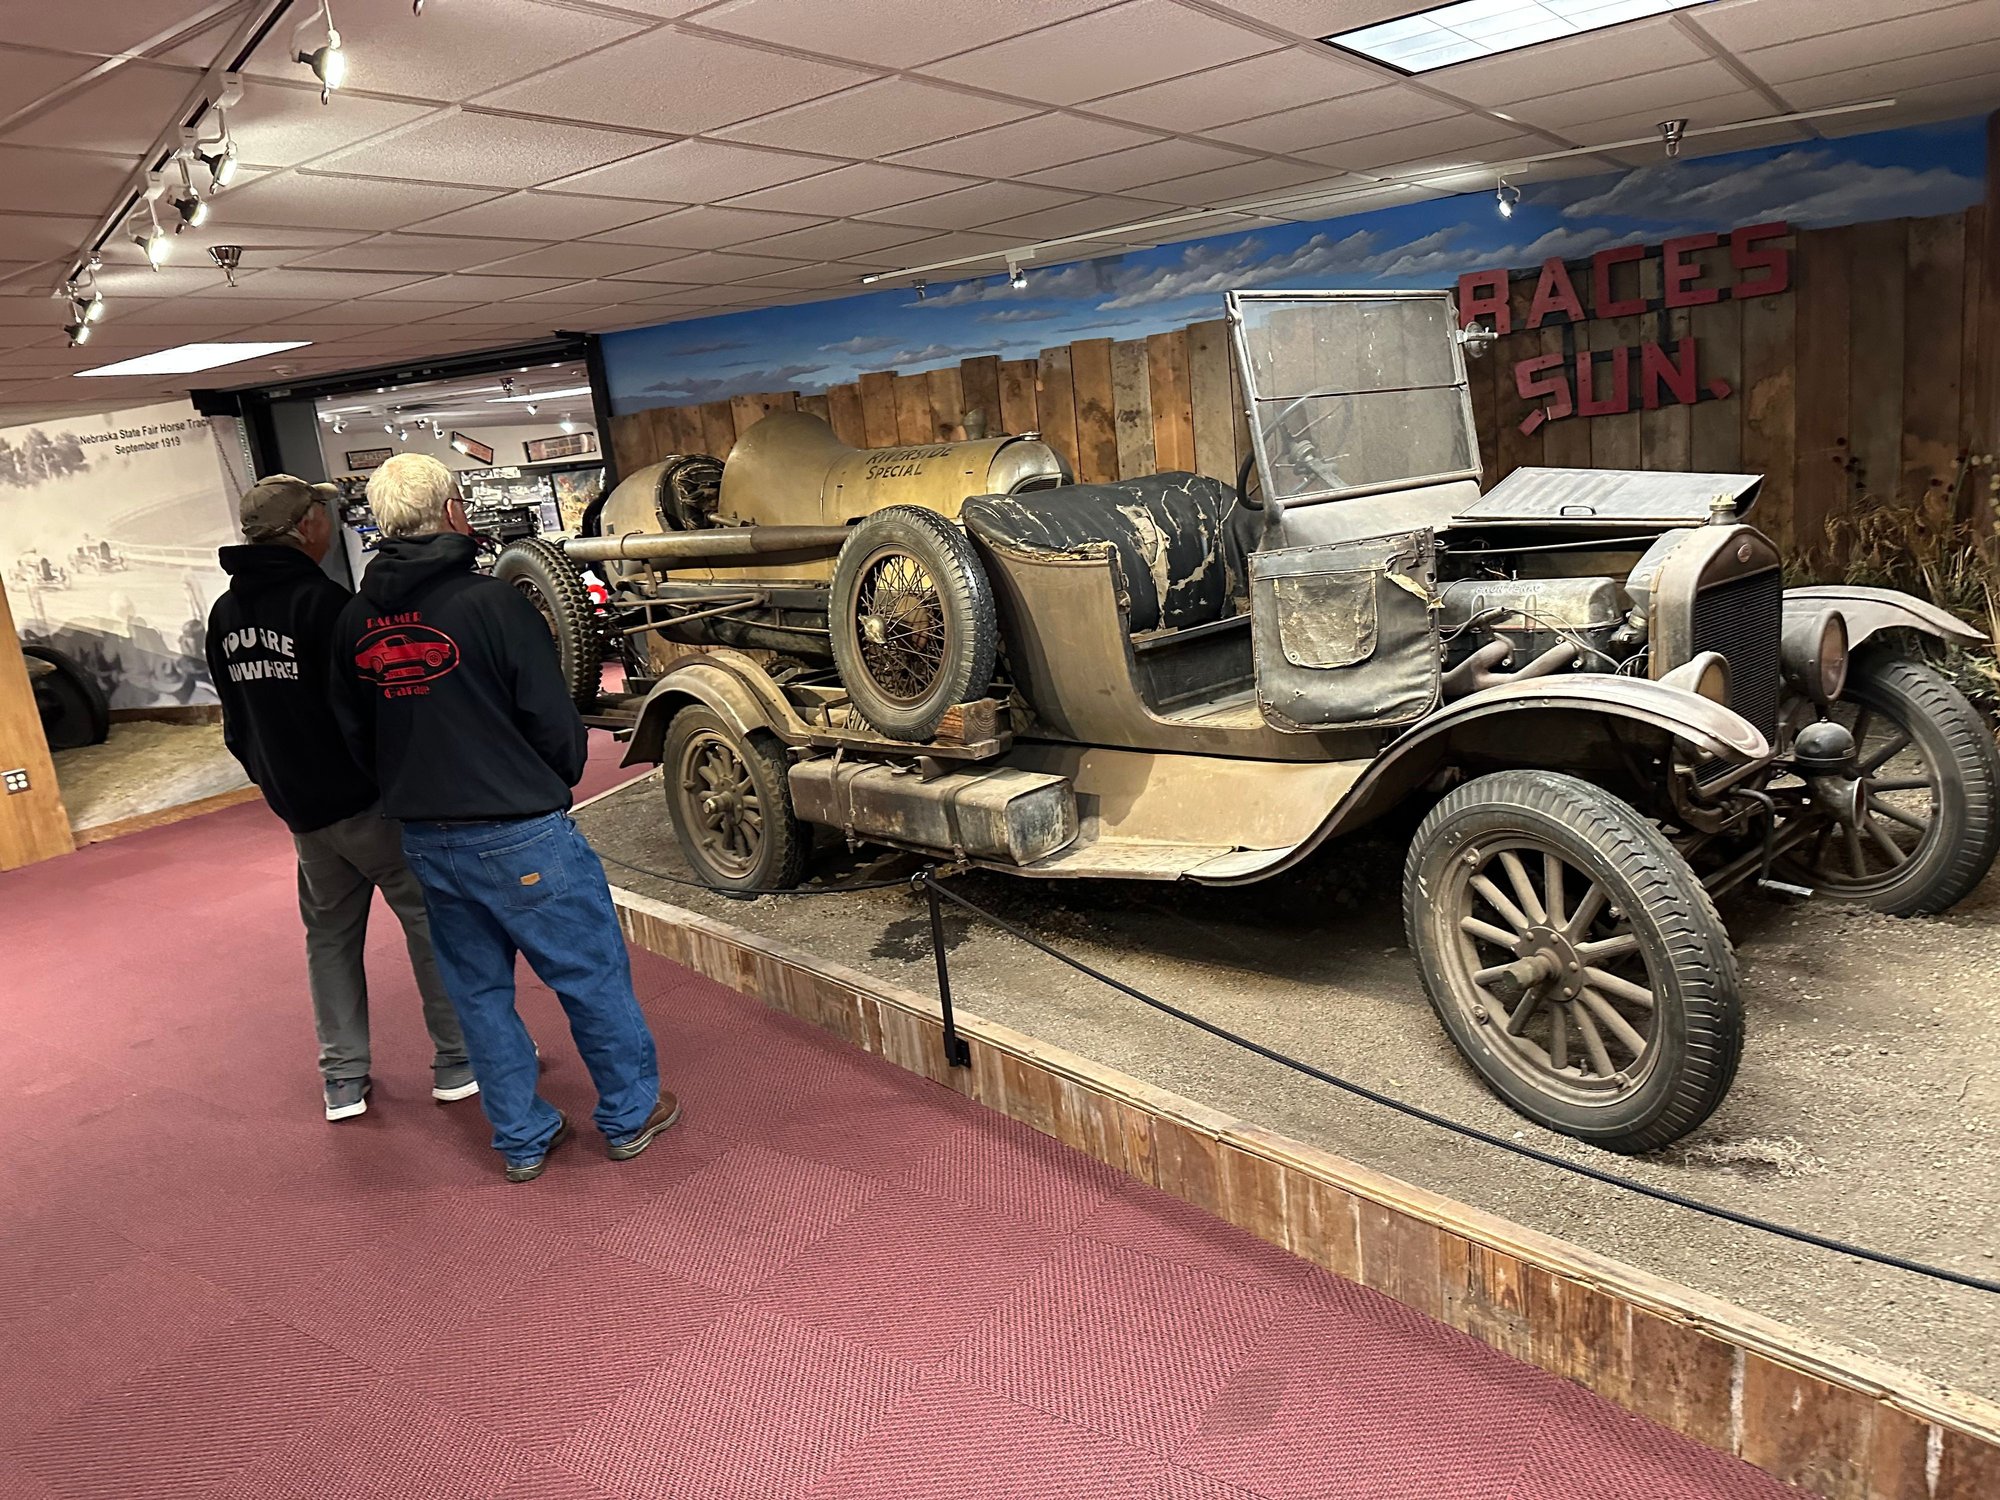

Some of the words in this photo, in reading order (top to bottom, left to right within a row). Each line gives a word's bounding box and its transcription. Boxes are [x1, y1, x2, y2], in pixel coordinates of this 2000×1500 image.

[1458, 220, 1788, 335] RACES
[79, 432, 119, 445] Nebraska
[118, 429, 141, 439] State
[142, 425, 159, 435] Fair
[160, 421, 186, 434] Horse
[114, 439, 159, 455] September
[161, 436, 181, 448] 1919
[865, 446, 955, 465] RIVERSIDE
[865, 463, 923, 480] SPECIAL
[221, 627, 258, 659] YOU
